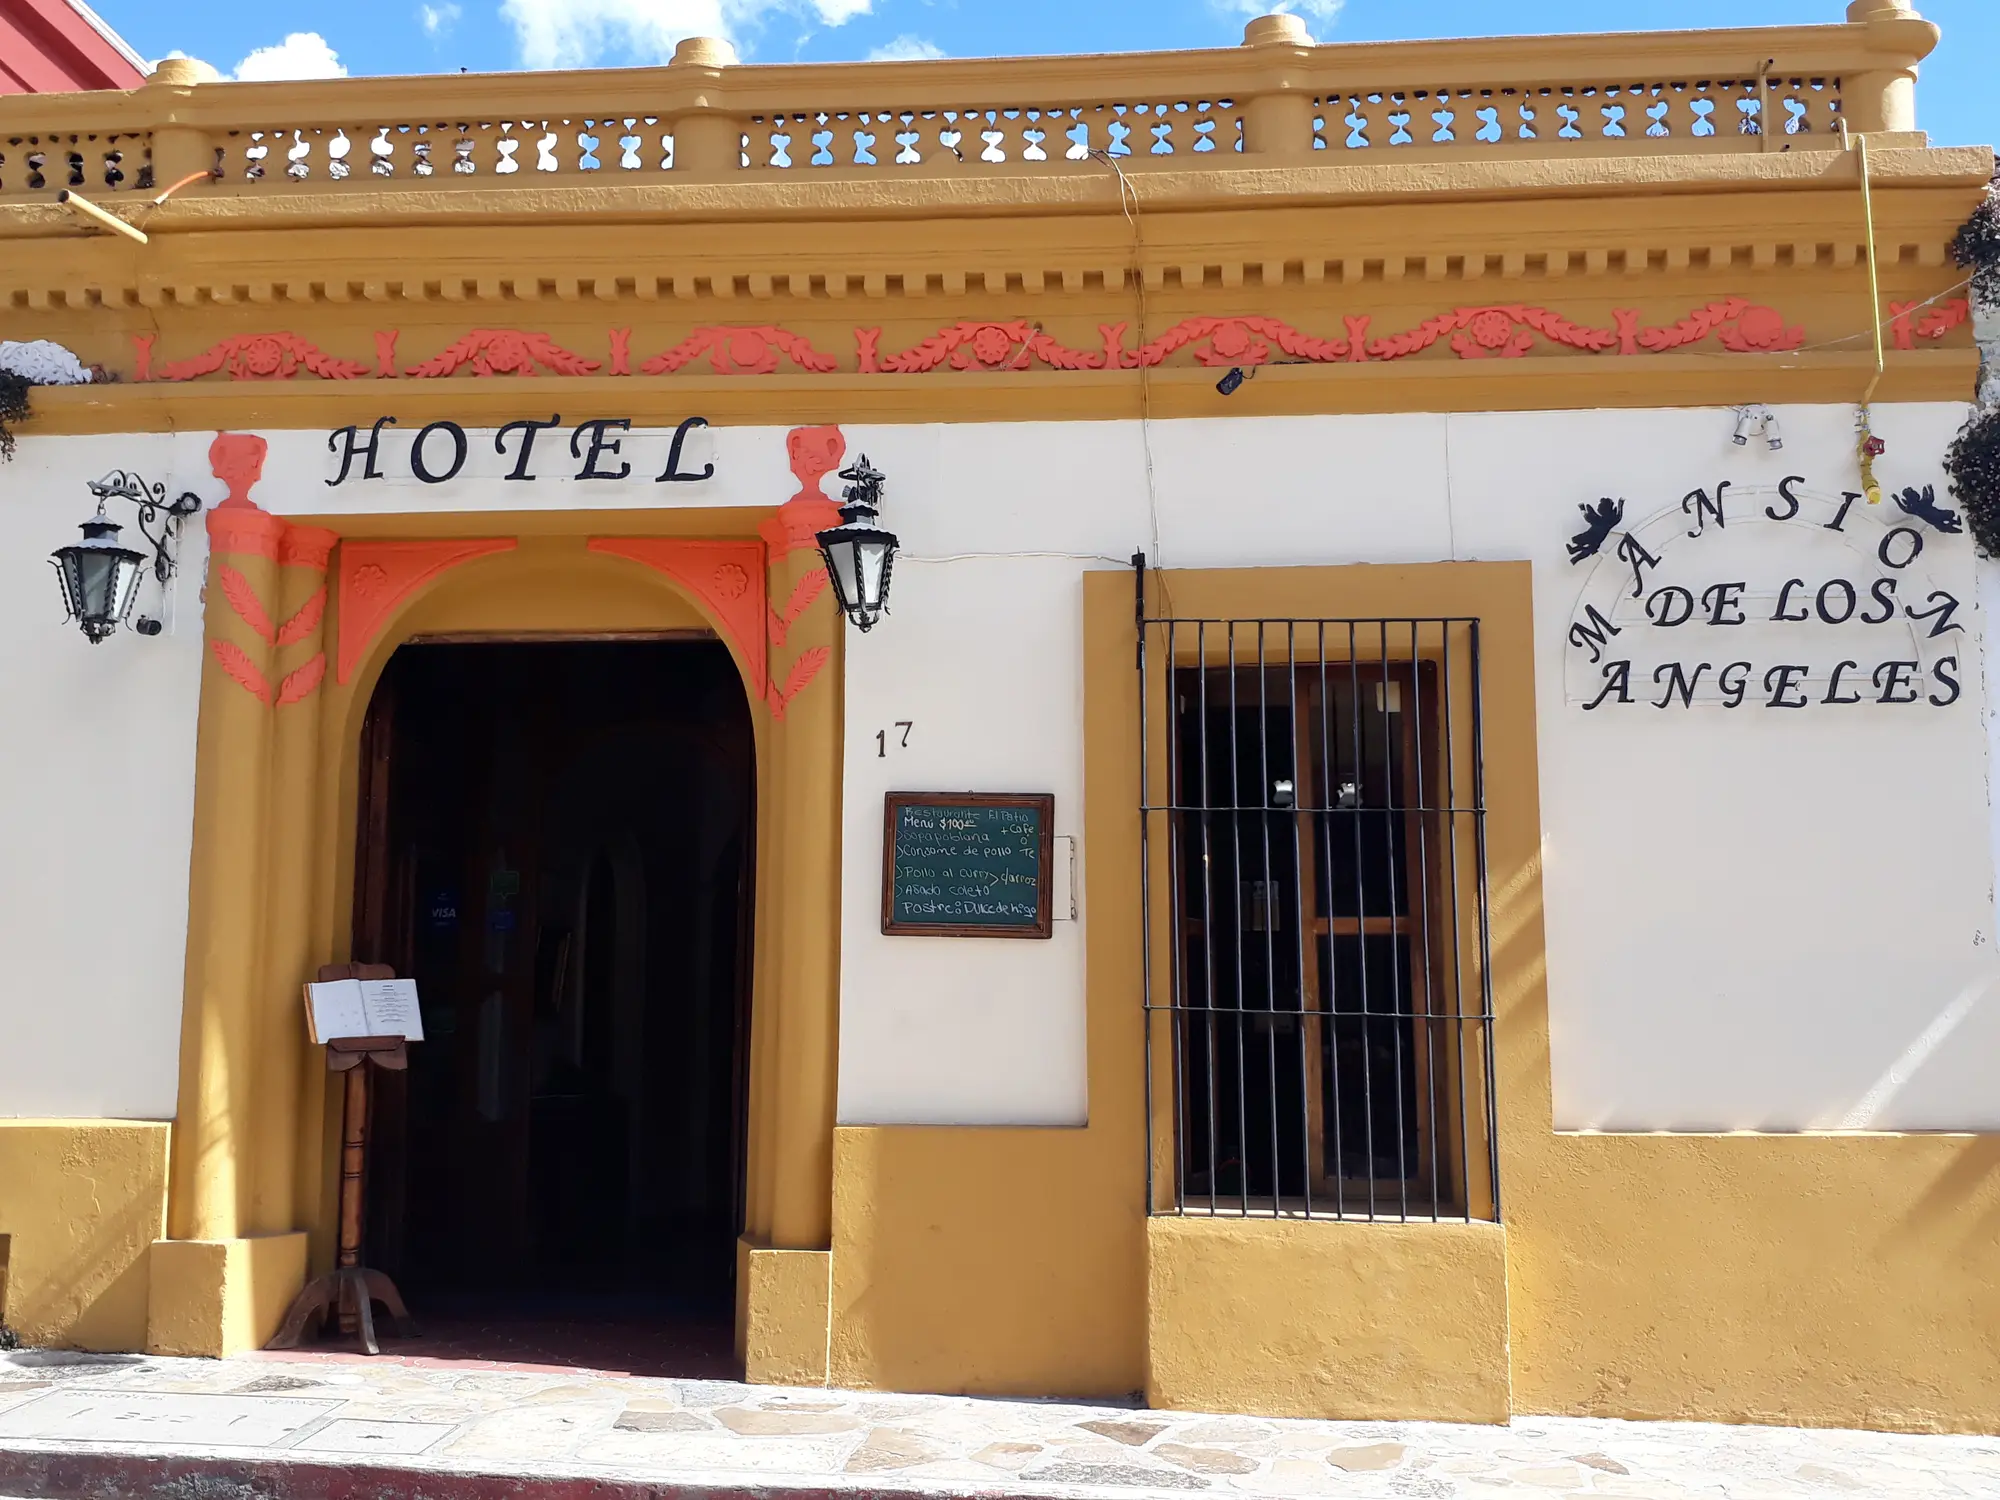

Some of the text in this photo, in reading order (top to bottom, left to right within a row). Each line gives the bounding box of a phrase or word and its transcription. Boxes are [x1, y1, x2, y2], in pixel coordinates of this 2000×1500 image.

[325, 413, 715, 486] HOTEL
[1569, 476, 1965, 663] MANSION
[1645, 578, 1897, 627] DE LOS
[1581, 656, 1961, 710] ANGELES
[876, 721, 913, 757] 17
[988, 809, 998, 820] El
[1001, 810, 1029, 822] Patio
[963, 845, 980, 856] de
[983, 846, 1012, 858] pollo
[904, 866, 989, 880] Pollo al curry
[432, 907, 456, 918] VISA
